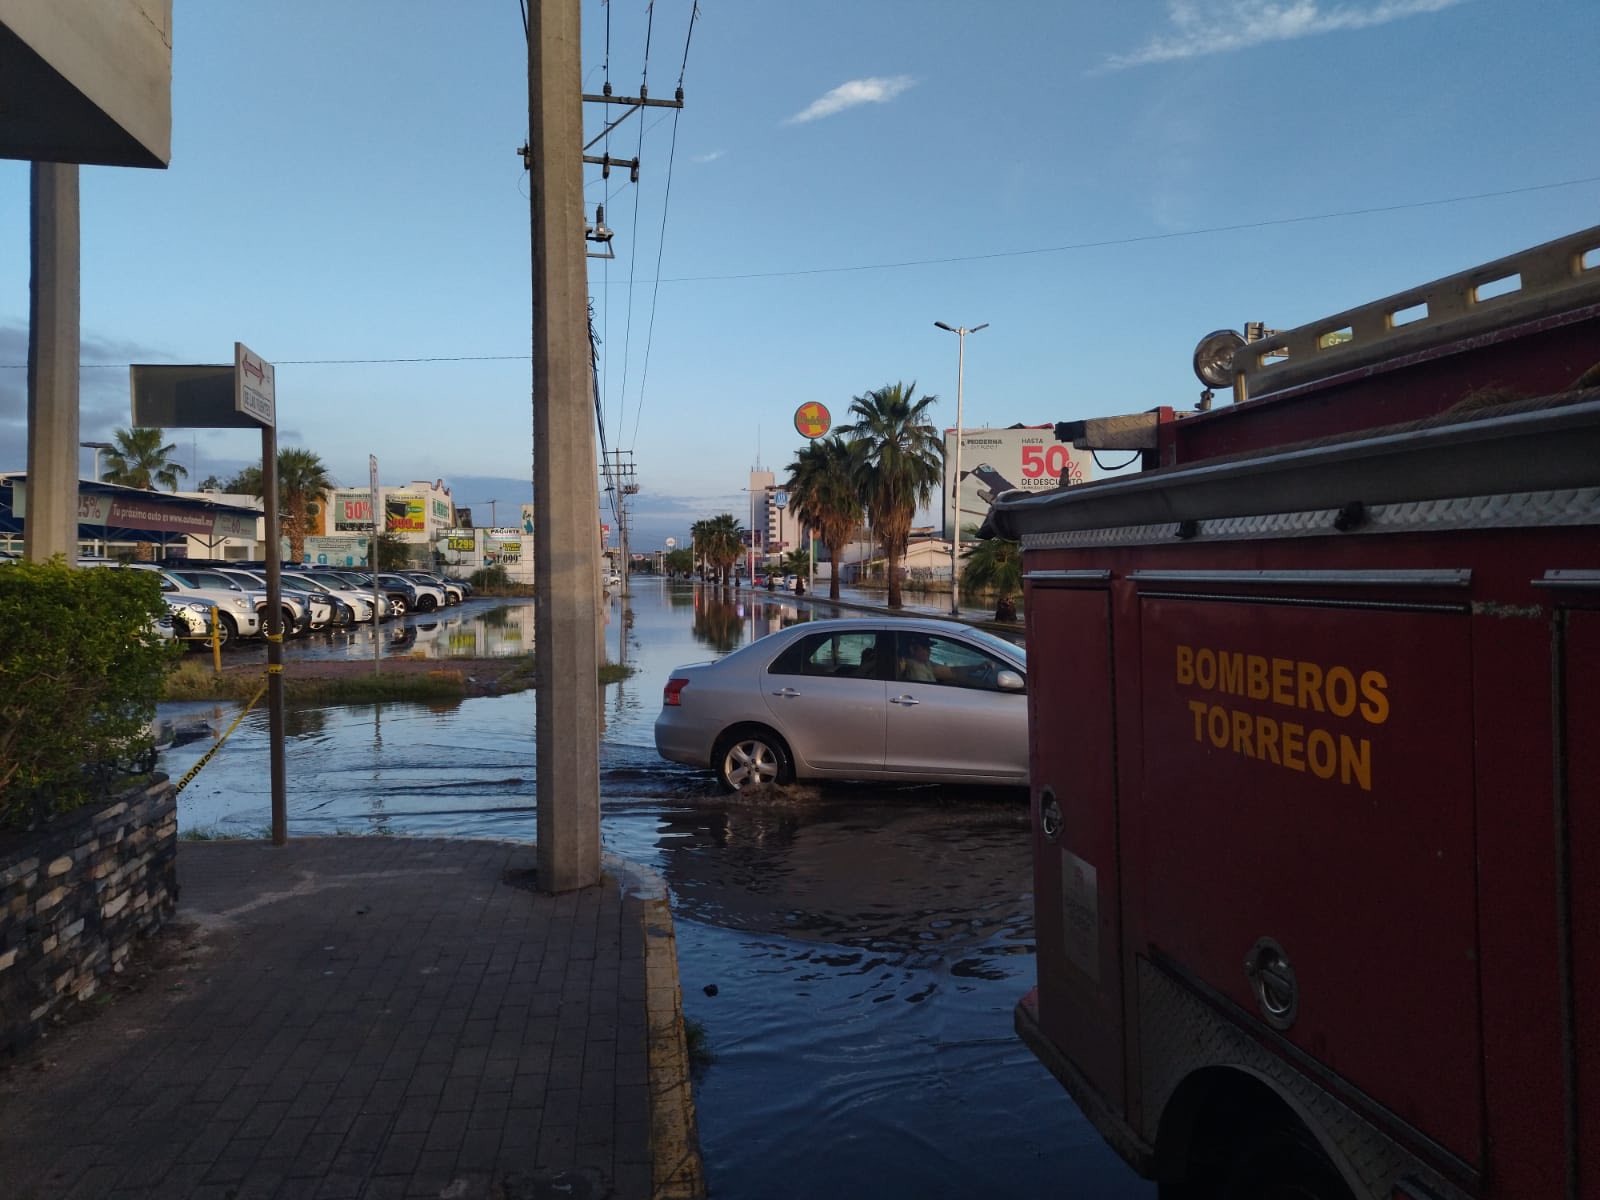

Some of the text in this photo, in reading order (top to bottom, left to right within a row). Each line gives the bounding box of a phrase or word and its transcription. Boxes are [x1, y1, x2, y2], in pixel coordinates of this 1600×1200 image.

[1021, 478, 1083, 487] DE DESCUTO
[113, 503, 121, 516] Tu
[147, 511, 161, 521] auto
[1176, 645, 1390, 724] BOMBEROS
[1188, 700, 1372, 791] TORREON
